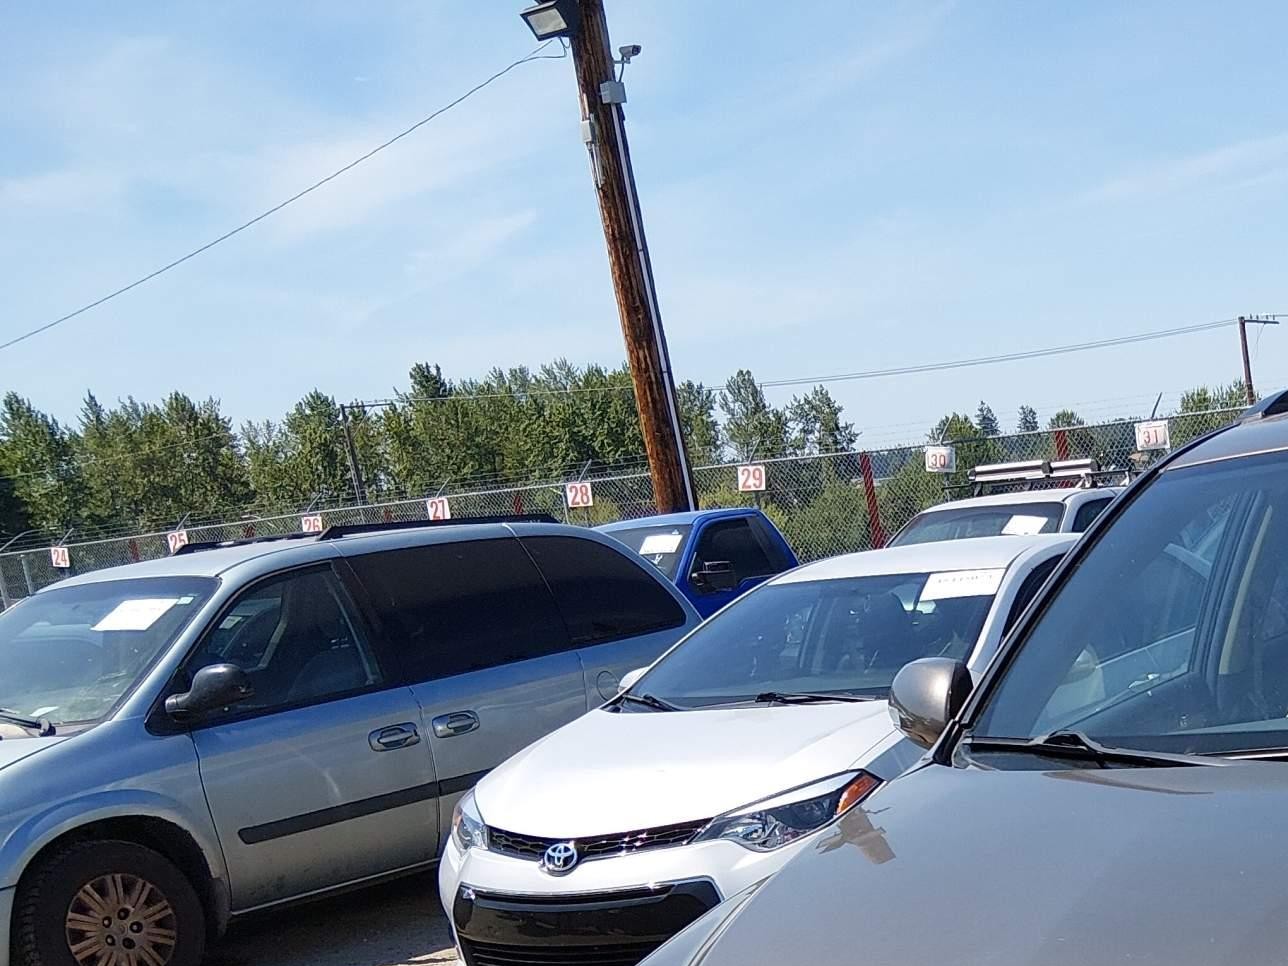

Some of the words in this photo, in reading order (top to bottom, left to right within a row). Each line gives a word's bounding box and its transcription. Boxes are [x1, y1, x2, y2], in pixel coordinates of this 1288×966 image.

[1143, 429, 1159, 444] 31
[931, 454, 946, 468] 30
[741, 468, 763, 489] 29
[569, 485, 590, 505] 28
[430, 500, 446, 520] 27
[304, 518, 320, 532] 26
[170, 533, 186, 552] 25
[53, 549, 67, 566] 24
